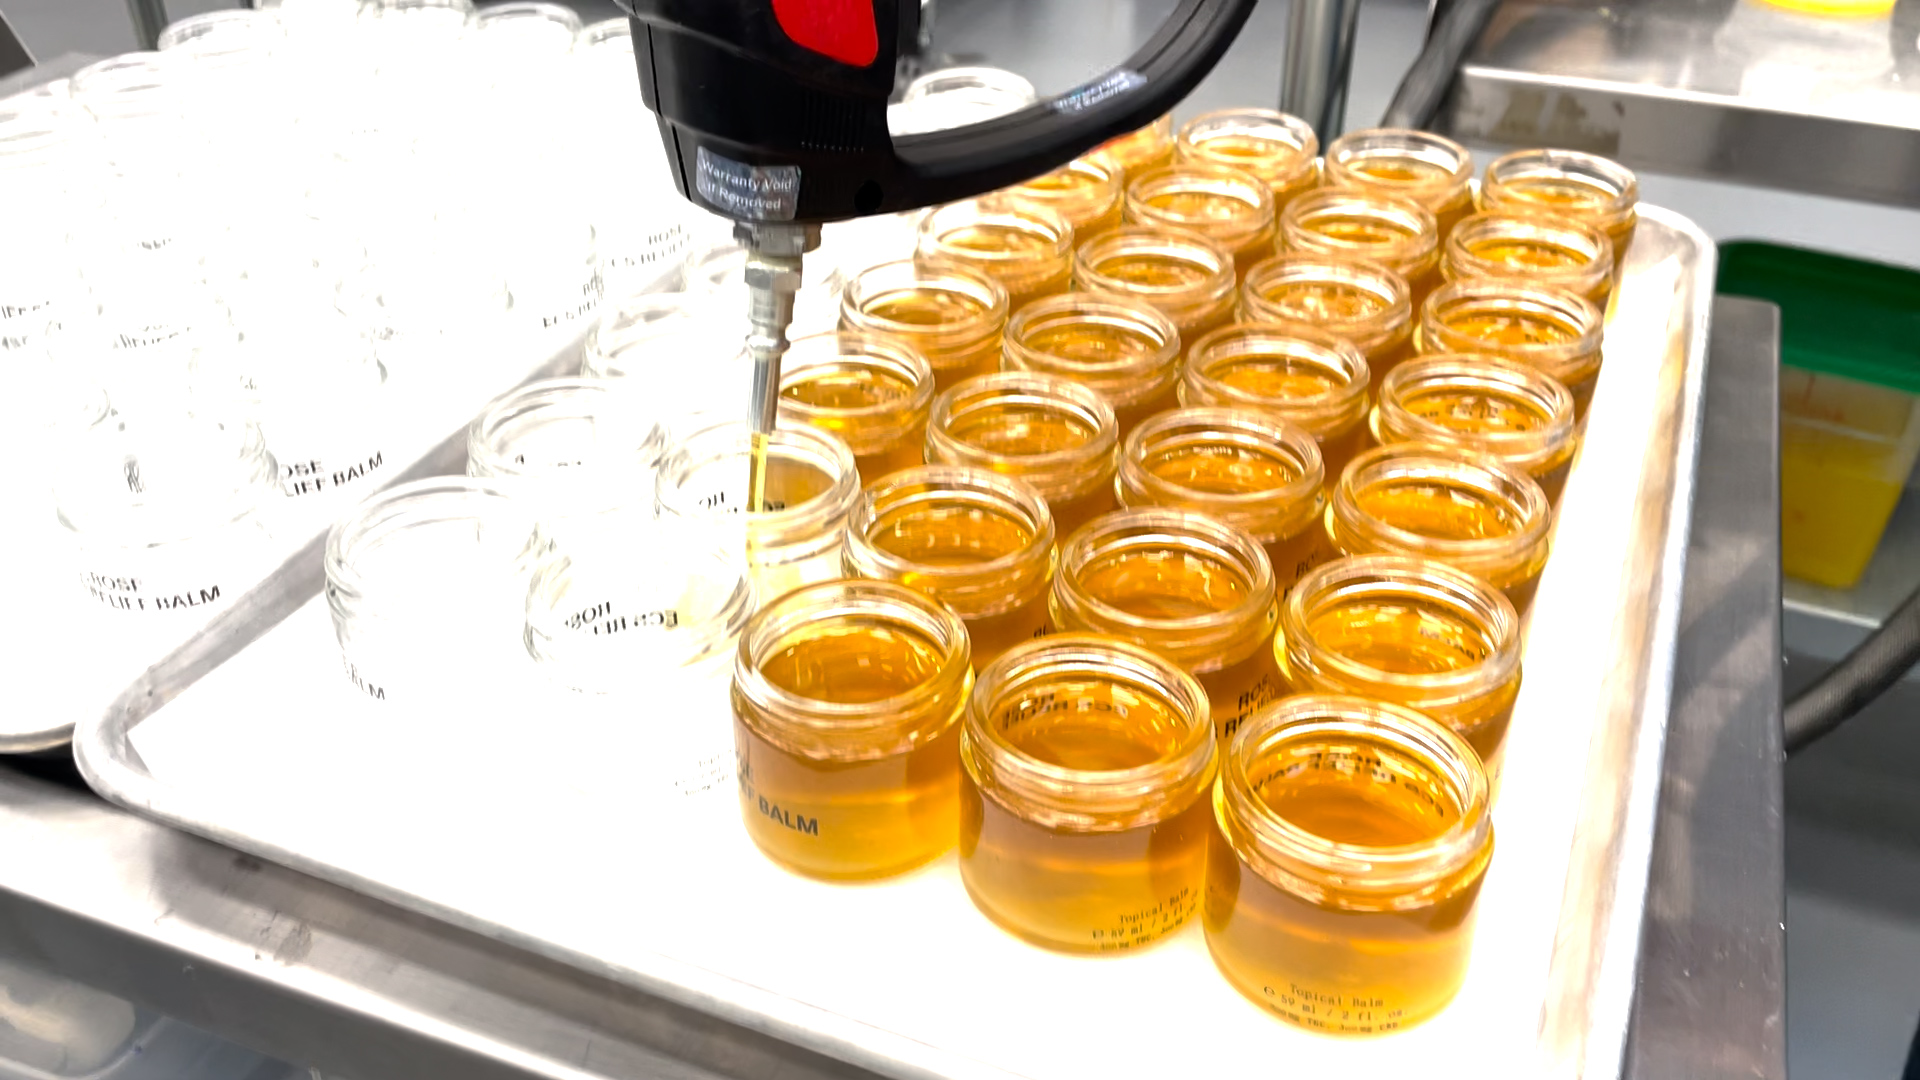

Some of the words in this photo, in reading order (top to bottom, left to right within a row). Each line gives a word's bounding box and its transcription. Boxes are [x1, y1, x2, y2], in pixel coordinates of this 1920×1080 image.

[702, 159, 760, 191] Warranty
[764, 178, 793, 192] Void
[719, 188, 782, 210] Removed
[333, 450, 383, 488] BALM
[156, 585, 220, 610] BALM
[758, 794, 819, 837] BALM
[1119, 902, 1163, 925] Topical
[1281, 994, 1296, 1006] 59
[1302, 1003, 1316, 1014] ml
[1326, 1008, 1333, 1017] /
[1342, 1010, 1350, 1021] 2
[1289, 982, 1342, 1007] Topical
[1352, 996, 1384, 1008] Balm
